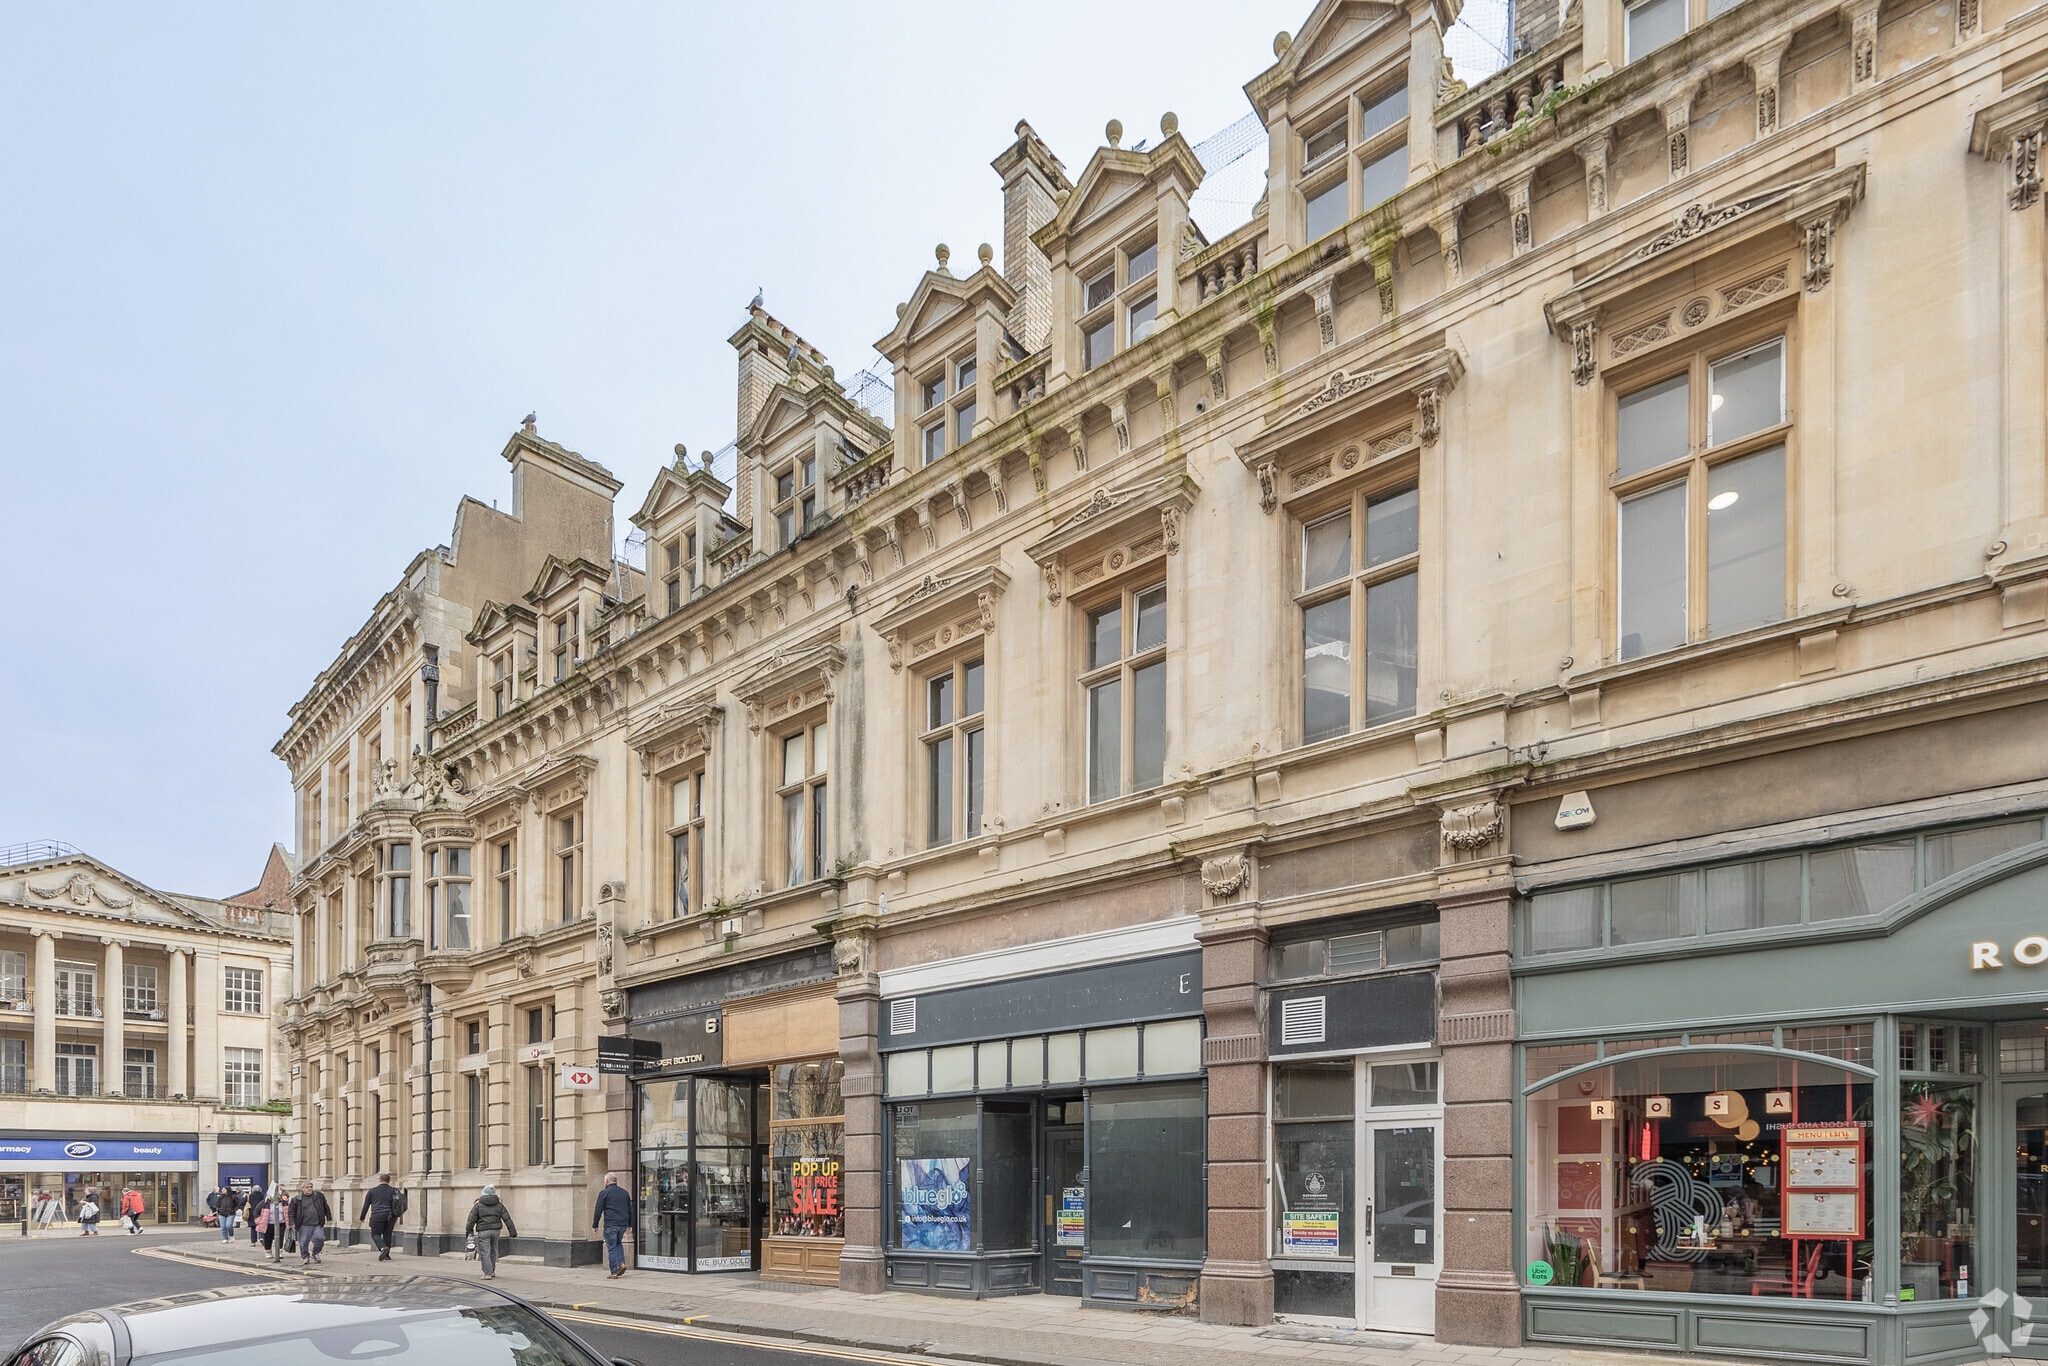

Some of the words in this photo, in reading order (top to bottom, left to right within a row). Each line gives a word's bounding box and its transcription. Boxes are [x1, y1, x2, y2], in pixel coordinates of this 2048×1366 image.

[1559, 807, 1590, 818] SECOM
[705, 1018, 718, 1034] 6
[673, 1054, 703, 1065] BOLTON
[133, 1146, 162, 1154] beauty
[793, 1162, 818, 1176] POP
[822, 1162, 839, 1176] UP
[814, 1176, 838, 1187] PRICE
[792, 1188, 837, 1215] SALE
[904, 1185, 962, 1210] blueglo
